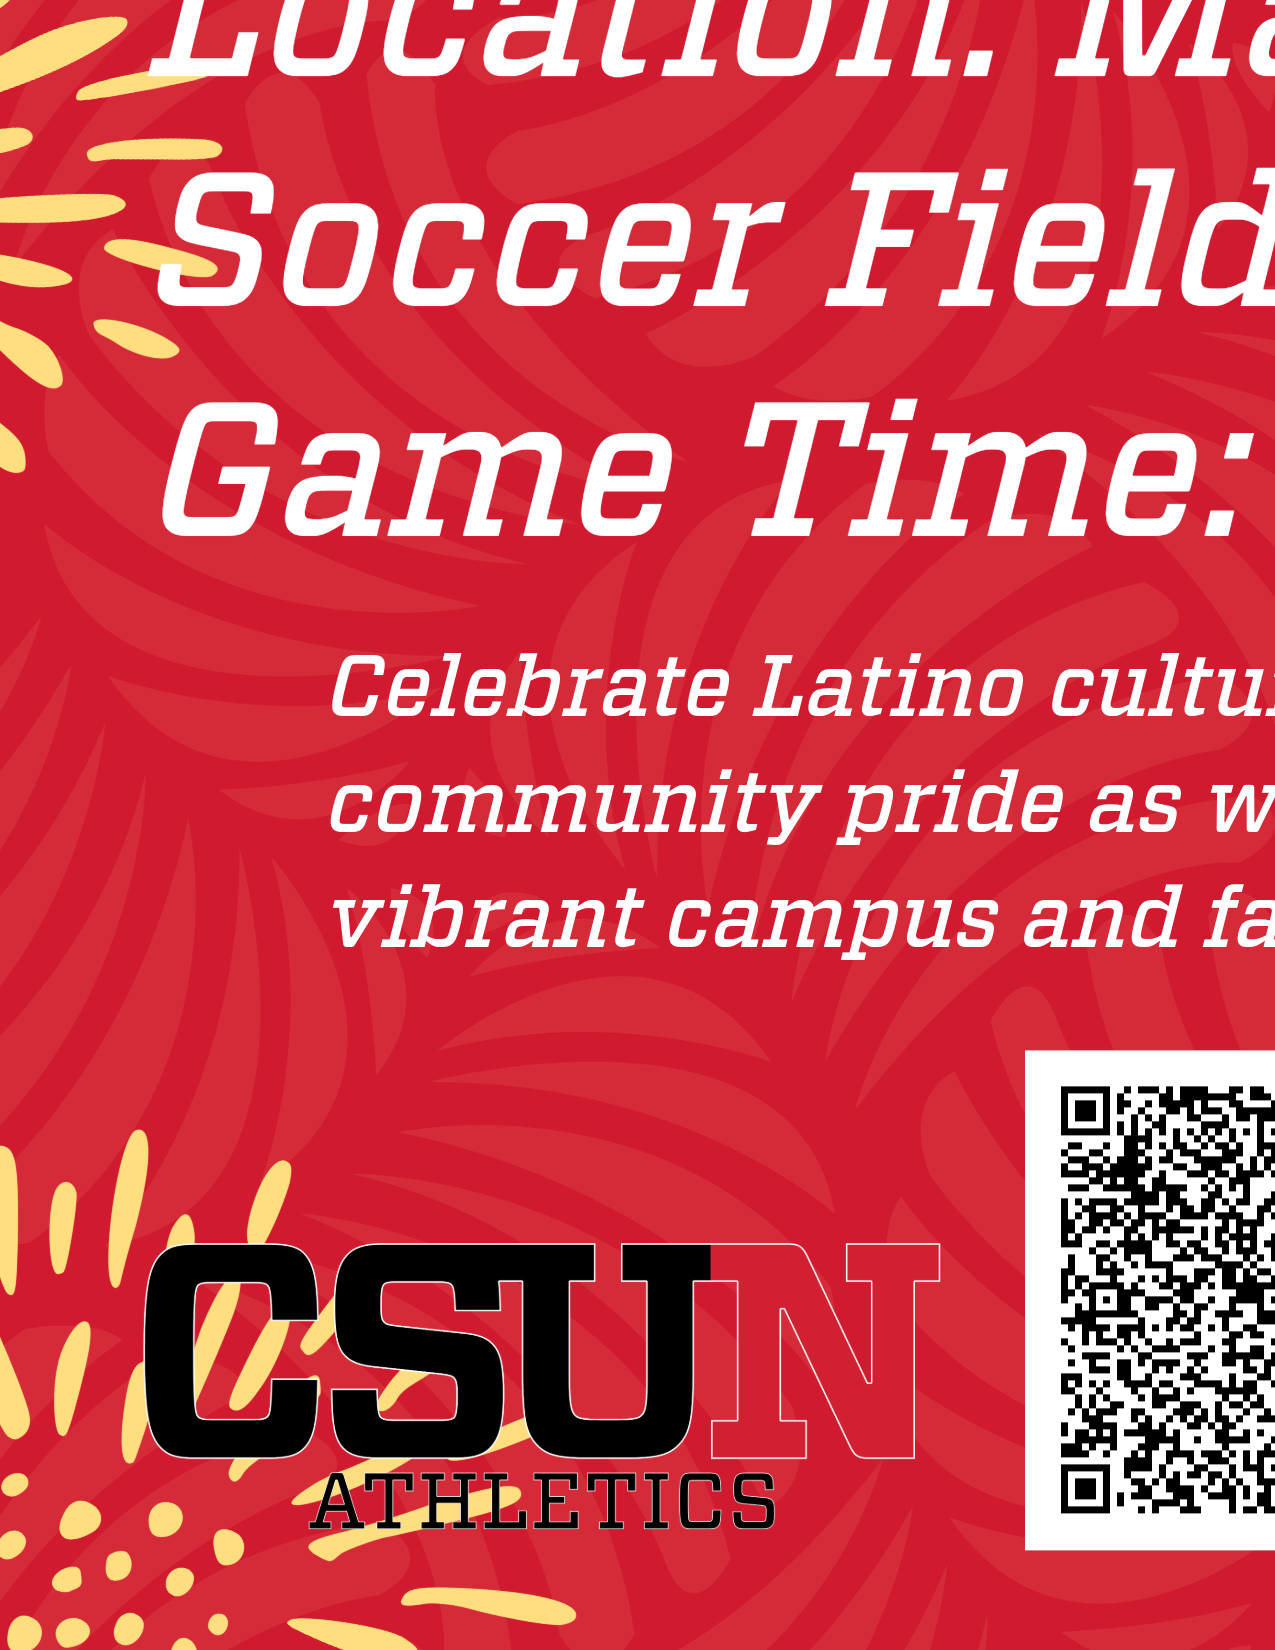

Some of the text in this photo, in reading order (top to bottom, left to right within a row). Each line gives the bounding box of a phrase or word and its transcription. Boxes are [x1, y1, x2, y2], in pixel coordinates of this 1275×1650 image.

[158, 173, 785, 306] Soccer
[163, 403, 672, 536] Game
[744, 399, 1253, 536] Time:
[332, 653, 729, 716] Celebrate
[753, 653, 1023, 716] Latino
[331, 769, 822, 845] community
[836, 769, 1063, 845] pride
[1090, 785, 1181, 832] as
[333, 884, 644, 947] vibrant
[669, 900, 998, 960] campus
[1024, 885, 1182, 947] and
[144, 1243, 941, 1459] CSUN
[308, 1472, 777, 1530] ATHLETICS
